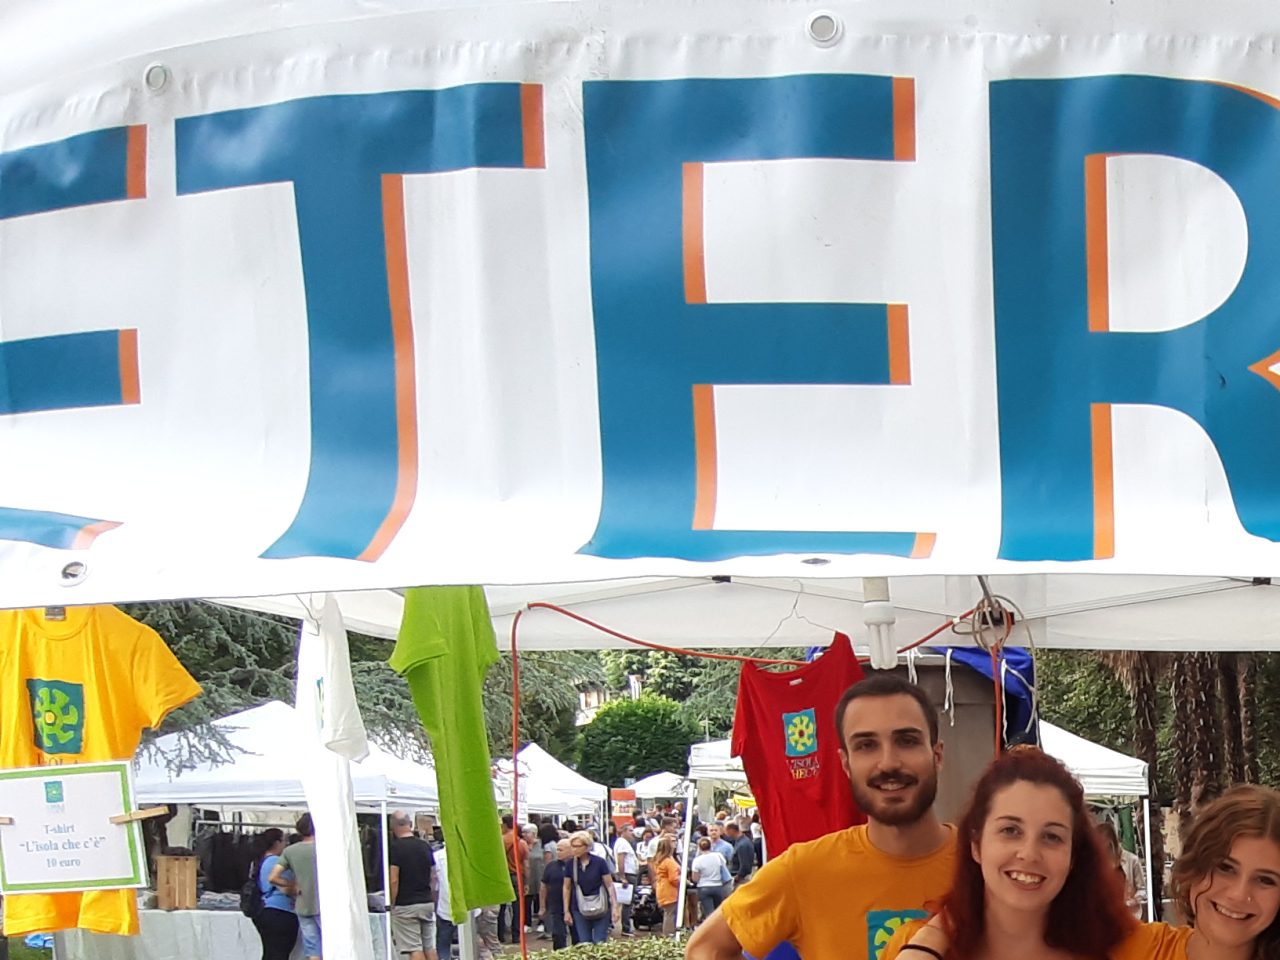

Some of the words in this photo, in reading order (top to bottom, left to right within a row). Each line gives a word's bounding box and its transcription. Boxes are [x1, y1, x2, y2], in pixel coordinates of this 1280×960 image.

[44, 823, 75, 835] T-shirt
[62, 838, 81, 850] che
[46, 858, 57, 868] 10
[60, 858, 81, 867] euro
